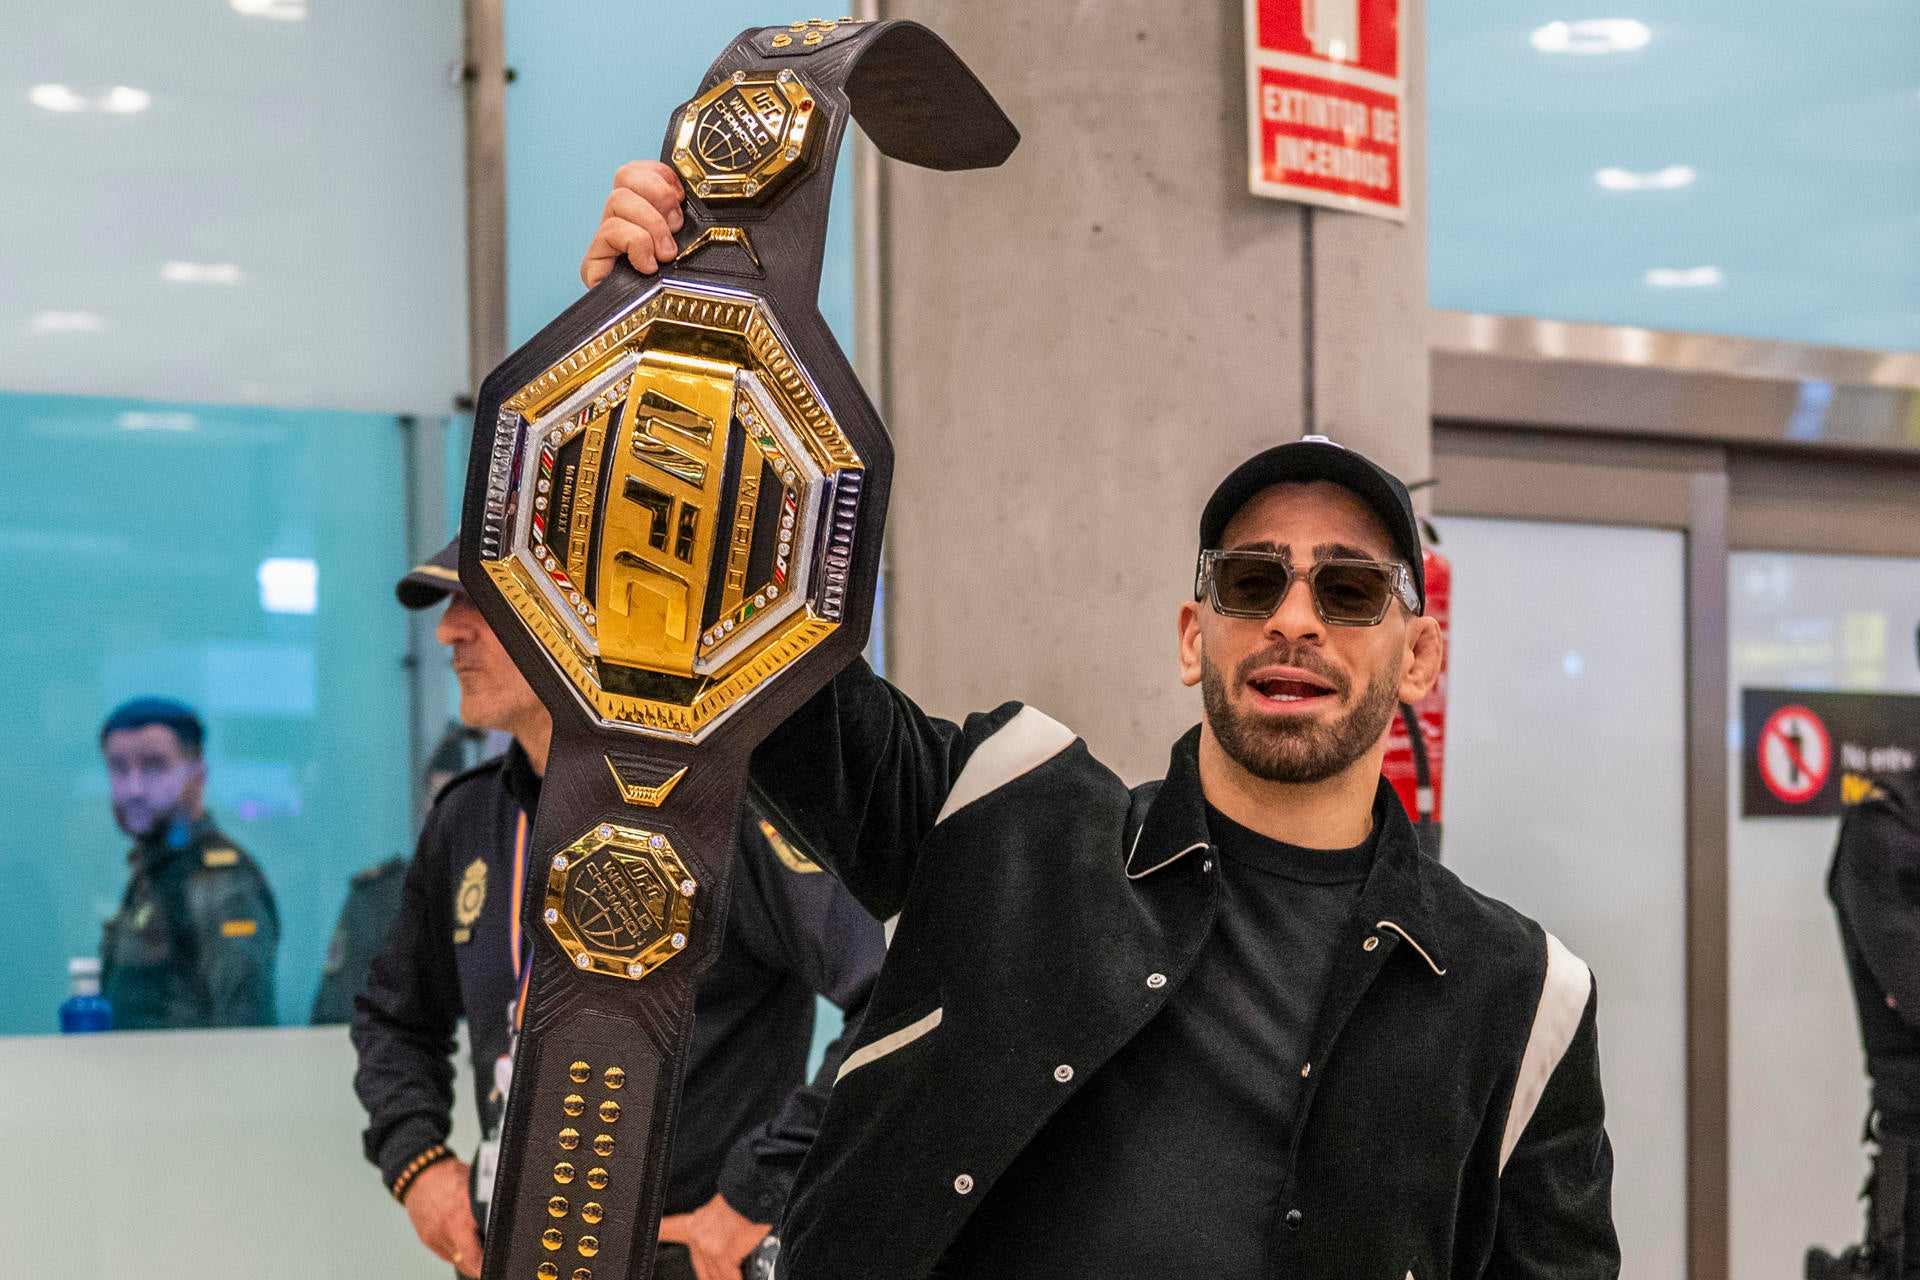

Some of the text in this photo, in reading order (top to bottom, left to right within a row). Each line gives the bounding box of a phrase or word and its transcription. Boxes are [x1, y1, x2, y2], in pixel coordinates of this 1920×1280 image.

[714, 99, 762, 160] CHAMPION
[729, 96, 769, 146] WORLD
[751, 90, 784, 127] UFC
[1263, 84, 1397, 144] EXTINTOR DE
[1275, 135, 1389, 189] INCENDIOS
[570, 427, 605, 579] CHAMPION
[609, 389, 716, 642] UFC
[727, 475, 758, 591] WORLD
[586, 861, 646, 946] CHAMPION
[603, 862, 652, 931] WORLD
[625, 862, 662, 902] UFC
